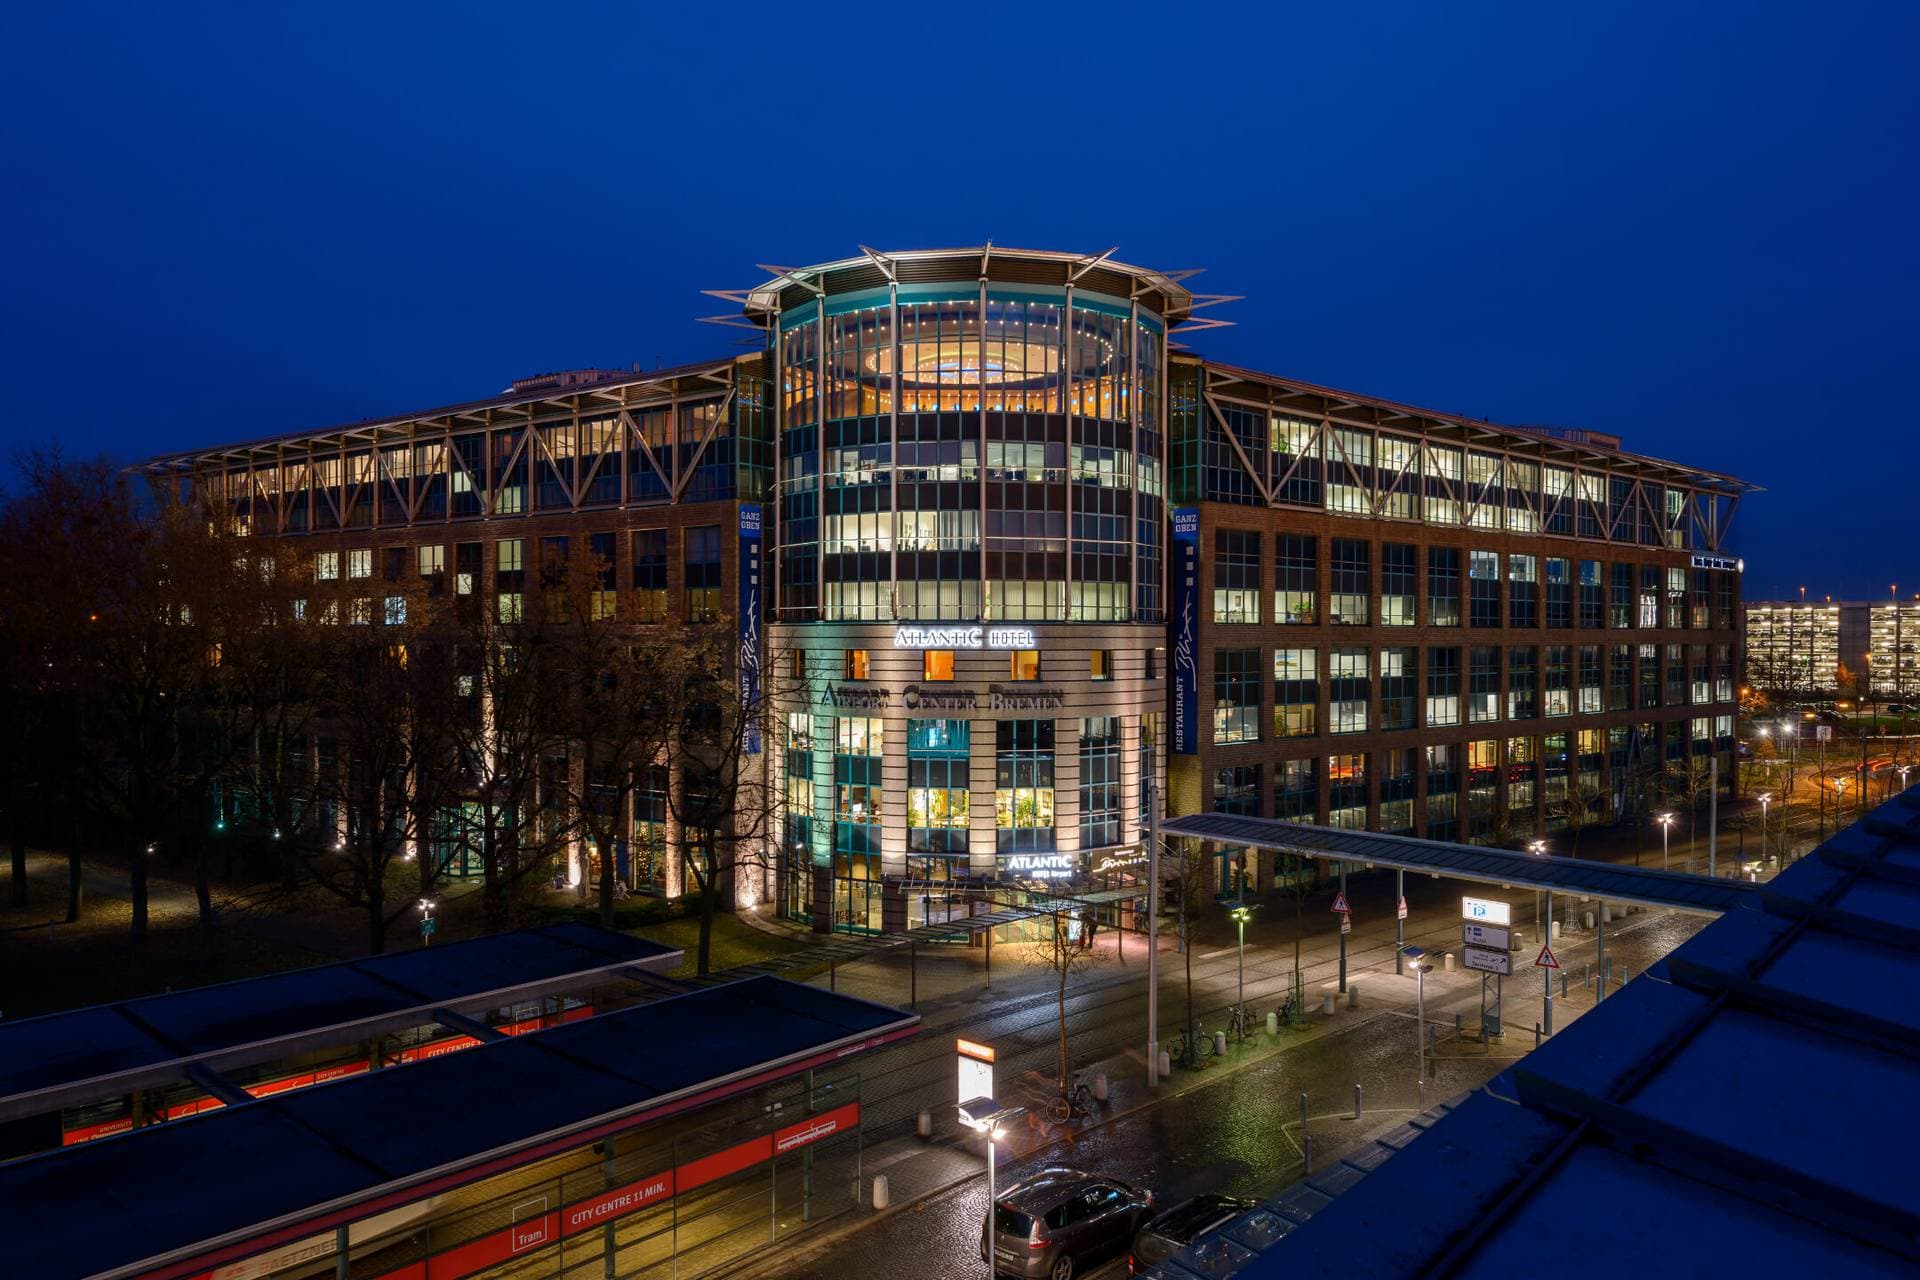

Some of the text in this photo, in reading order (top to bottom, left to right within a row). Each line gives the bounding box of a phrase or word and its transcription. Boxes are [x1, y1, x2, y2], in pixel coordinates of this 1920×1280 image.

[741, 512, 760, 520] GANZ
[1175, 515, 1197, 523] GANZ
[741, 521, 760, 529] OBEN
[1175, 524, 1197, 532] OBEN
[896, 629, 1034, 646] ATLANTIC HOTEL
[1176, 676, 1184, 751] RESTAURANT
[1008, 855, 1073, 870] ATLANTIC
[571, 1182, 666, 1225] CITY CENTRE 11 MIN.
[518, 1230, 542, 1246] Tram
